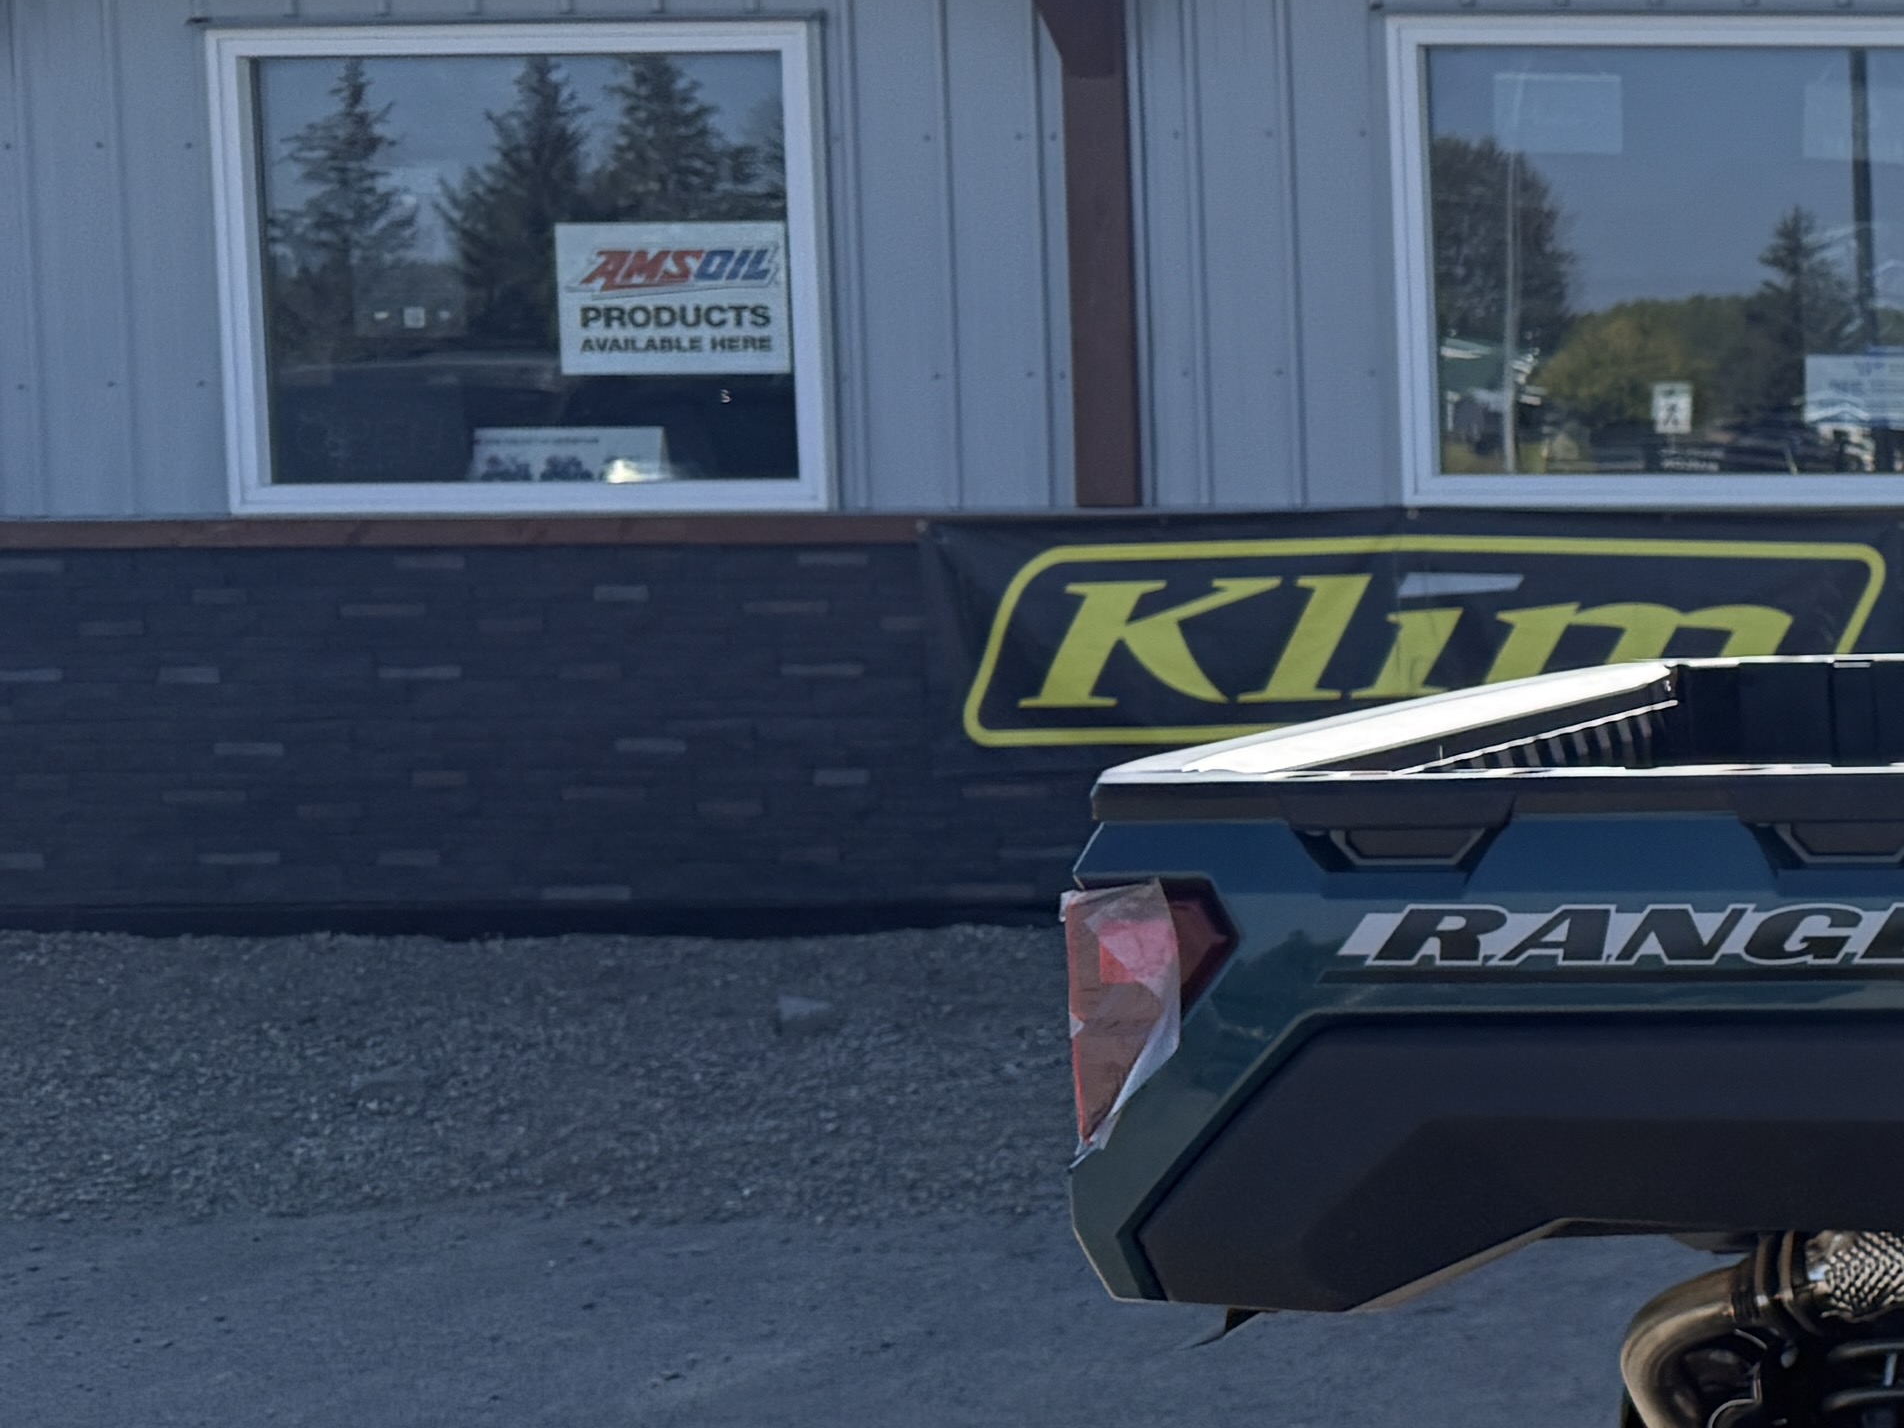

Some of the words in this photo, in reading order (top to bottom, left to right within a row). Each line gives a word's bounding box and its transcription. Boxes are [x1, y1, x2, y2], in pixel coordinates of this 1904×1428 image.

[579, 249, 771, 292] AMSOIL
[579, 304, 771, 329] PRODUCTS
[580, 335, 703, 353] AVAILABLE
[709, 335, 772, 352] HERE
